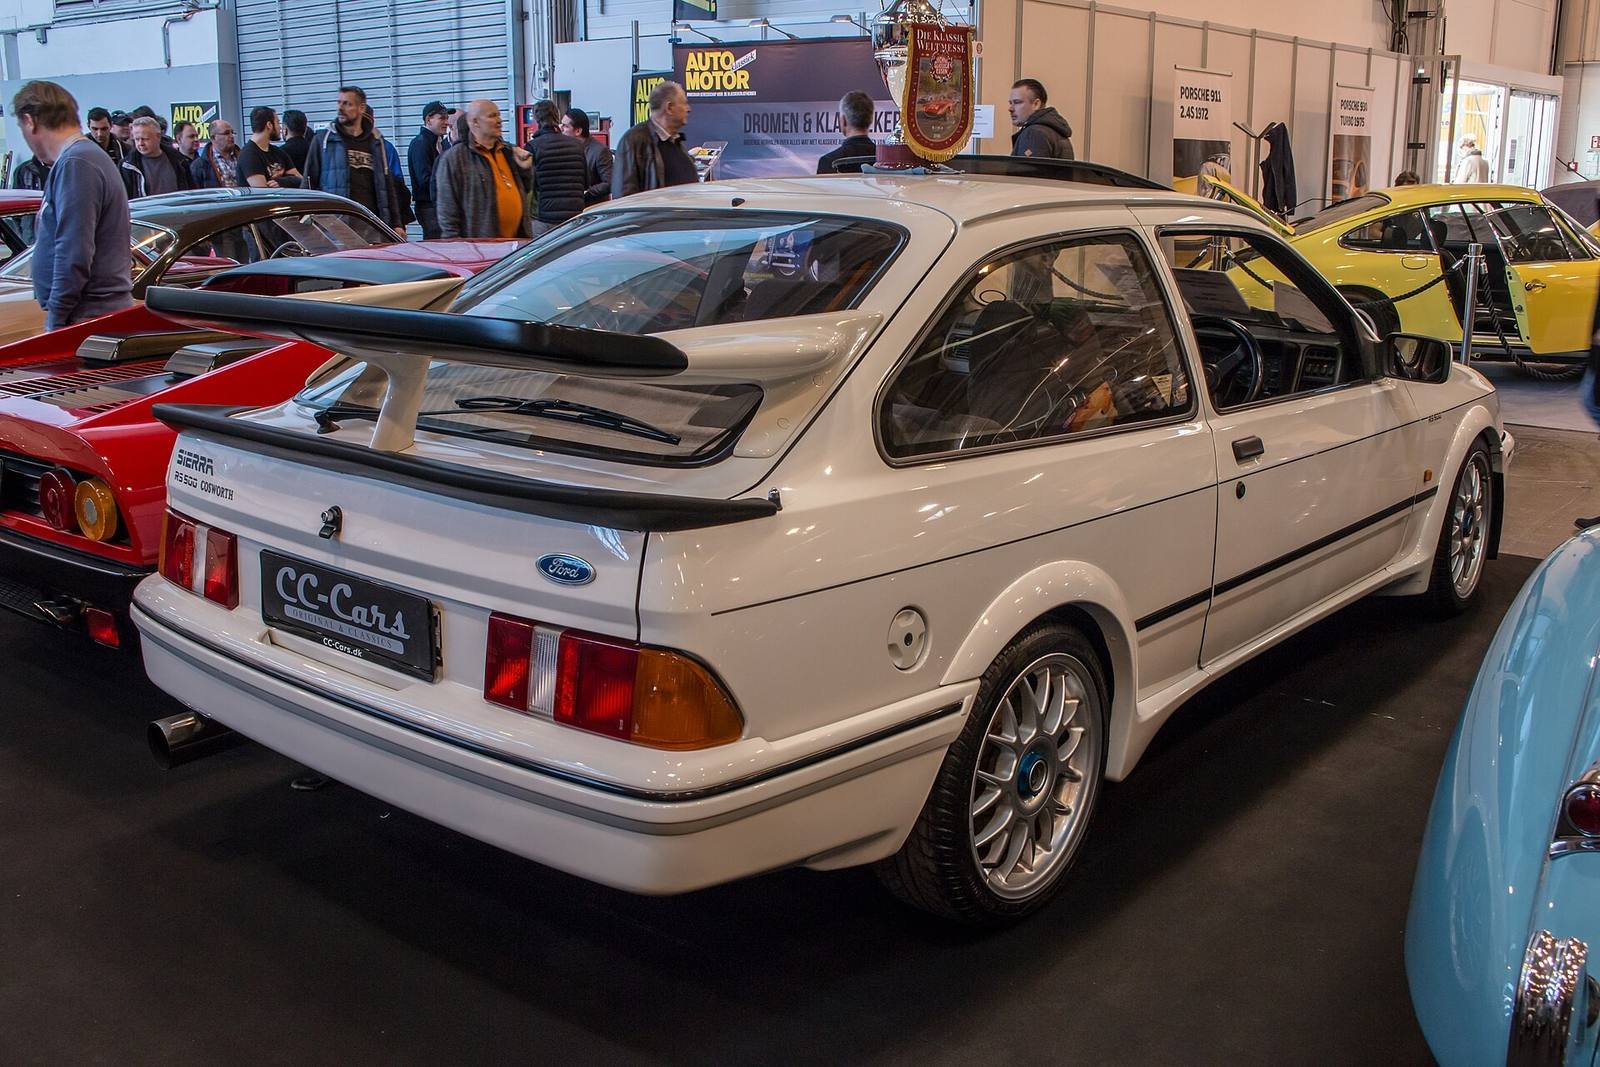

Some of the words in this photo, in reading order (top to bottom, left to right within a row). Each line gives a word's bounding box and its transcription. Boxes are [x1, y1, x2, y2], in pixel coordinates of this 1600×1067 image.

[917, 29, 931, 40] DIE
[686, 51, 735, 71] AUTO
[686, 70, 750, 90] MOTOR
[1180, 86, 1209, 101] PORSCHE
[1210, 90, 1222, 102] 911
[173, 105, 202, 123] AUTO
[743, 112, 799, 133] DROMEN
[803, 112, 813, 133] &
[1195, 106, 1209, 120] 1972
[177, 449, 214, 476] SIERRA
[200, 480, 234, 500] COSWORTH
[548, 558, 580, 578] Ford
[276, 566, 411, 640] CC-Cars
[292, 608, 334, 630] ORIGINAL
[346, 626, 393, 649] CLASSICS
[322, 637, 363, 657] CC-Cars.dk
